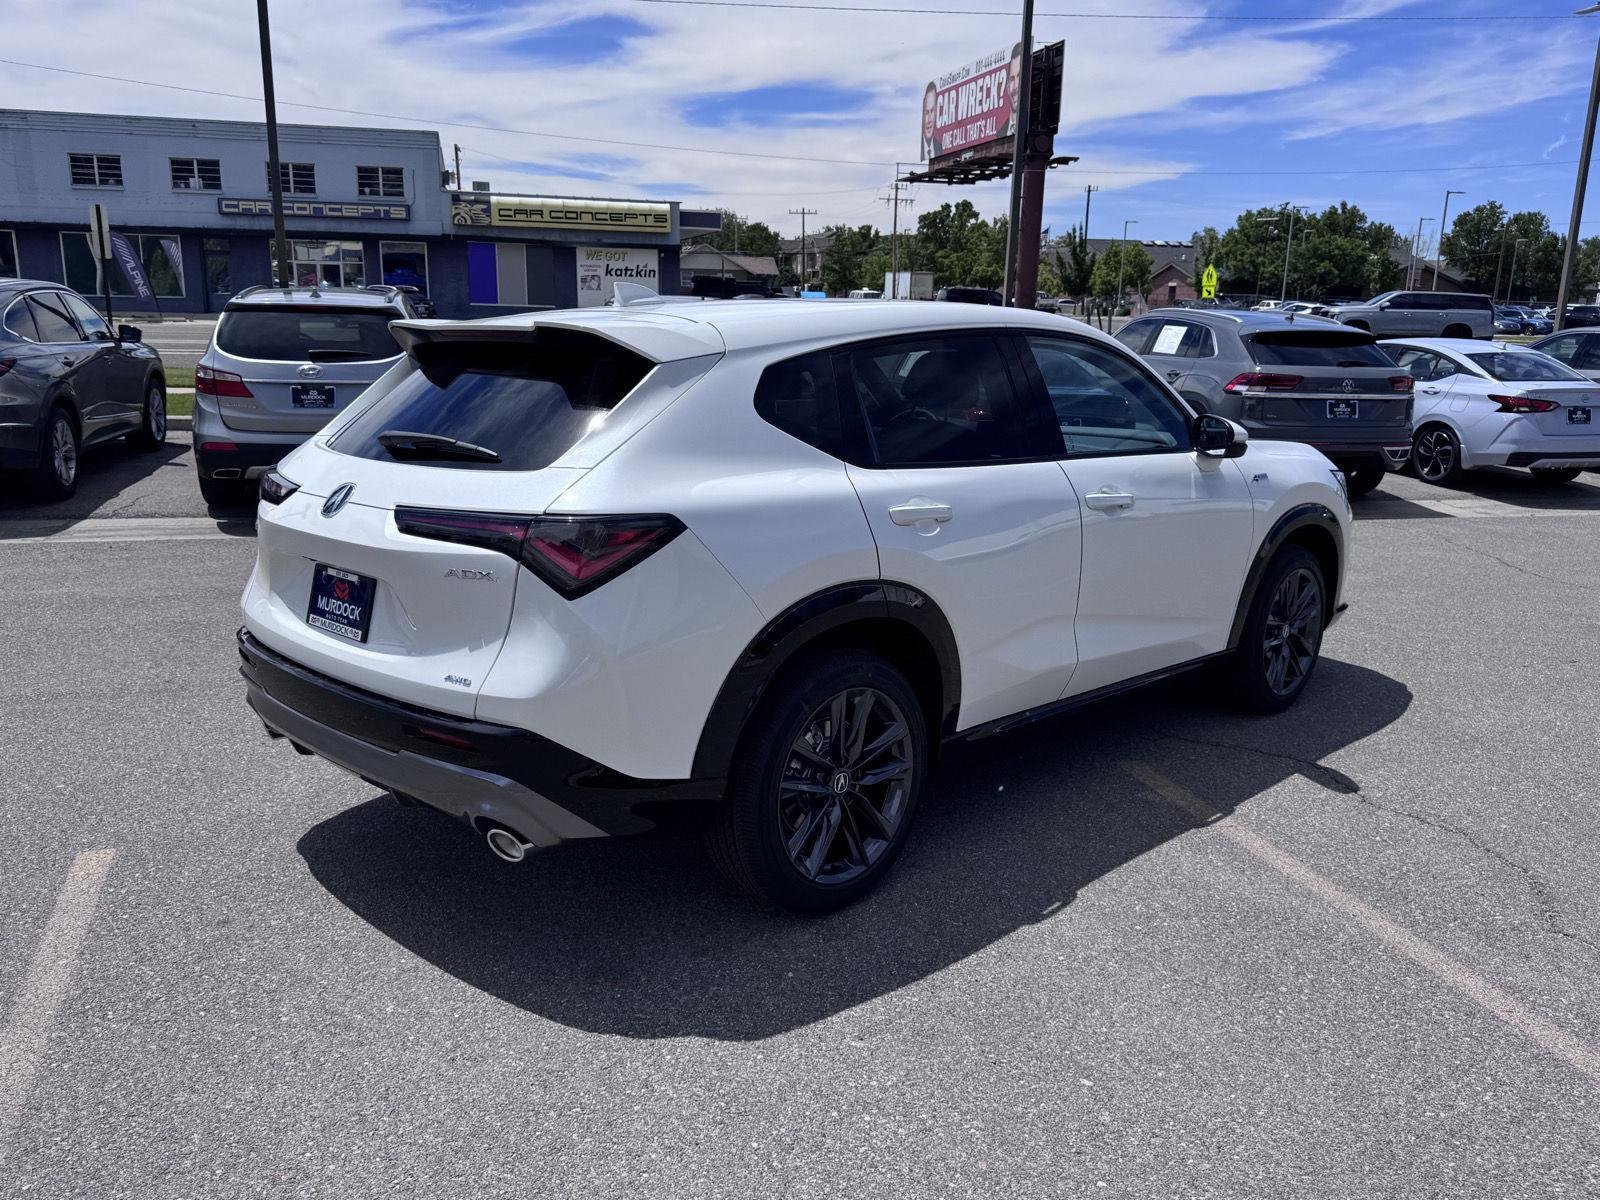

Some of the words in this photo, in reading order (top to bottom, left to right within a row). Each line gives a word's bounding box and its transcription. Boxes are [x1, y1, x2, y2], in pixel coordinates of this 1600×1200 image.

[936, 90, 956, 128] CAR
[958, 68, 1007, 120] WRECK?
[942, 131, 953, 150] ONE
[953, 126, 966, 146] CALL
[967, 118, 985, 142] THAT'S
[985, 116, 997, 137] ALL
[222, 200, 272, 213] CAR
[281, 202, 406, 218] CONCEPTS
[498, 207, 544, 219] CAR
[549, 210, 668, 223] CONCEPTS
[585, 249, 602, 261] WE
[604, 251, 628, 262] GOT
[120, 251, 150, 298] ALPINE
[604, 263, 656, 278] katzkin
[443, 568, 496, 582] ADX
[317, 594, 362, 621] MURDOCK
[320, 619, 350, 636] MURDOCK
